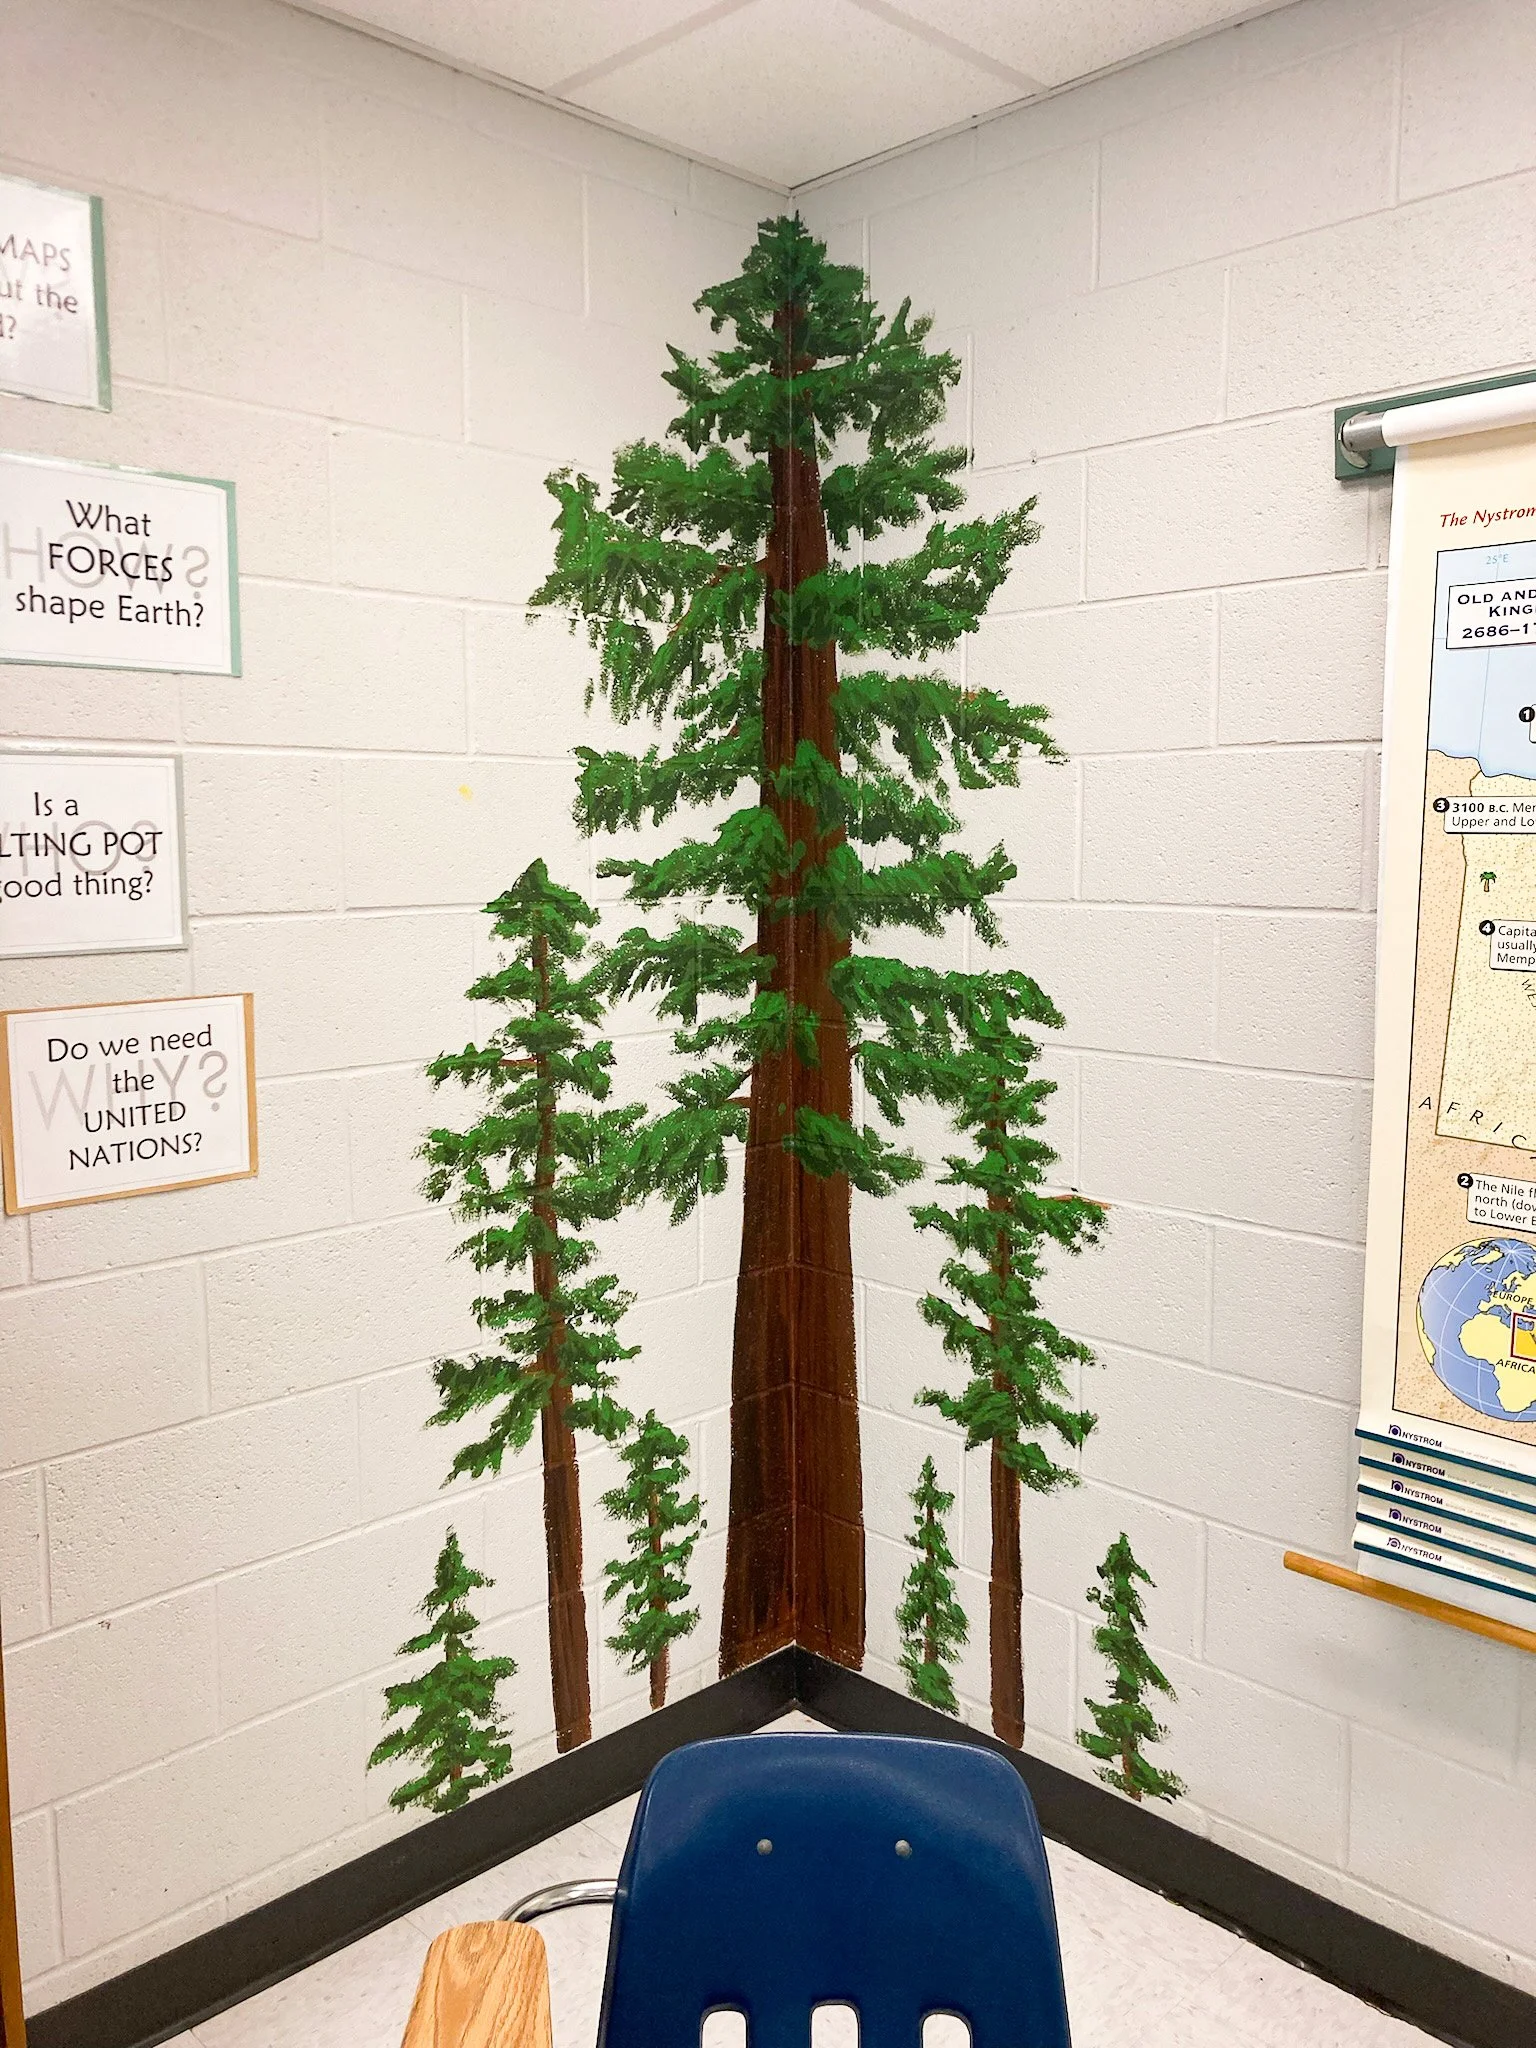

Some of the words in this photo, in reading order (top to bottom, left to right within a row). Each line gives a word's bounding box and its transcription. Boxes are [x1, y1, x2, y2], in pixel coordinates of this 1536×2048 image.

[36, 283, 78, 313] the
[66, 499, 151, 537] What
[1440, 512, 1468, 527] The
[48, 543, 172, 582] FORCES
[16, 585, 104, 623] shape
[119, 595, 203, 627] Earth?
[1458, 594, 1493, 605] OLD
[1501, 589, 1536, 602] AND
[1489, 604, 1536, 617] KING
[35, 792, 52, 816] Is
[65, 799, 78, 816] a
[1452, 803, 1485, 812] 3100
[1489, 805, 1509, 813] B.C.
[1452, 817, 1490, 829] Upper
[1493, 816, 1517, 827] and
[104, 832, 163, 855] POT
[0, 871, 61, 903] ood
[73, 871, 153, 900] thing?
[1498, 925, 1536, 938] Capita
[48, 1038, 88, 1062] Do
[99, 1038, 139, 1056] we
[151, 1024, 212, 1051] need
[113, 1070, 154, 1093] the
[85, 1102, 186, 1132] UNITED
[70, 1132, 202, 1170] NATIONS?
[1476, 1180, 1498, 1193] The
[1501, 1184, 1524, 1197] Nile
[1475, 1195, 1508, 1208] north
[1475, 1207, 1487, 1217] to
[1491, 1209, 1527, 1224] Lower
[1492, 1291, 1533, 1304] EUROPE
[1496, 1359, 1536, 1374] AFRICA
[1402, 1431, 1443, 1448] NYSTROM
[1406, 1459, 1446, 1477] NYSTROM
[1404, 1487, 1443, 1505] NYSTROM
[1402, 1516, 1442, 1534] NYSTROM
[1401, 1544, 1442, 1562] NYSTROM
